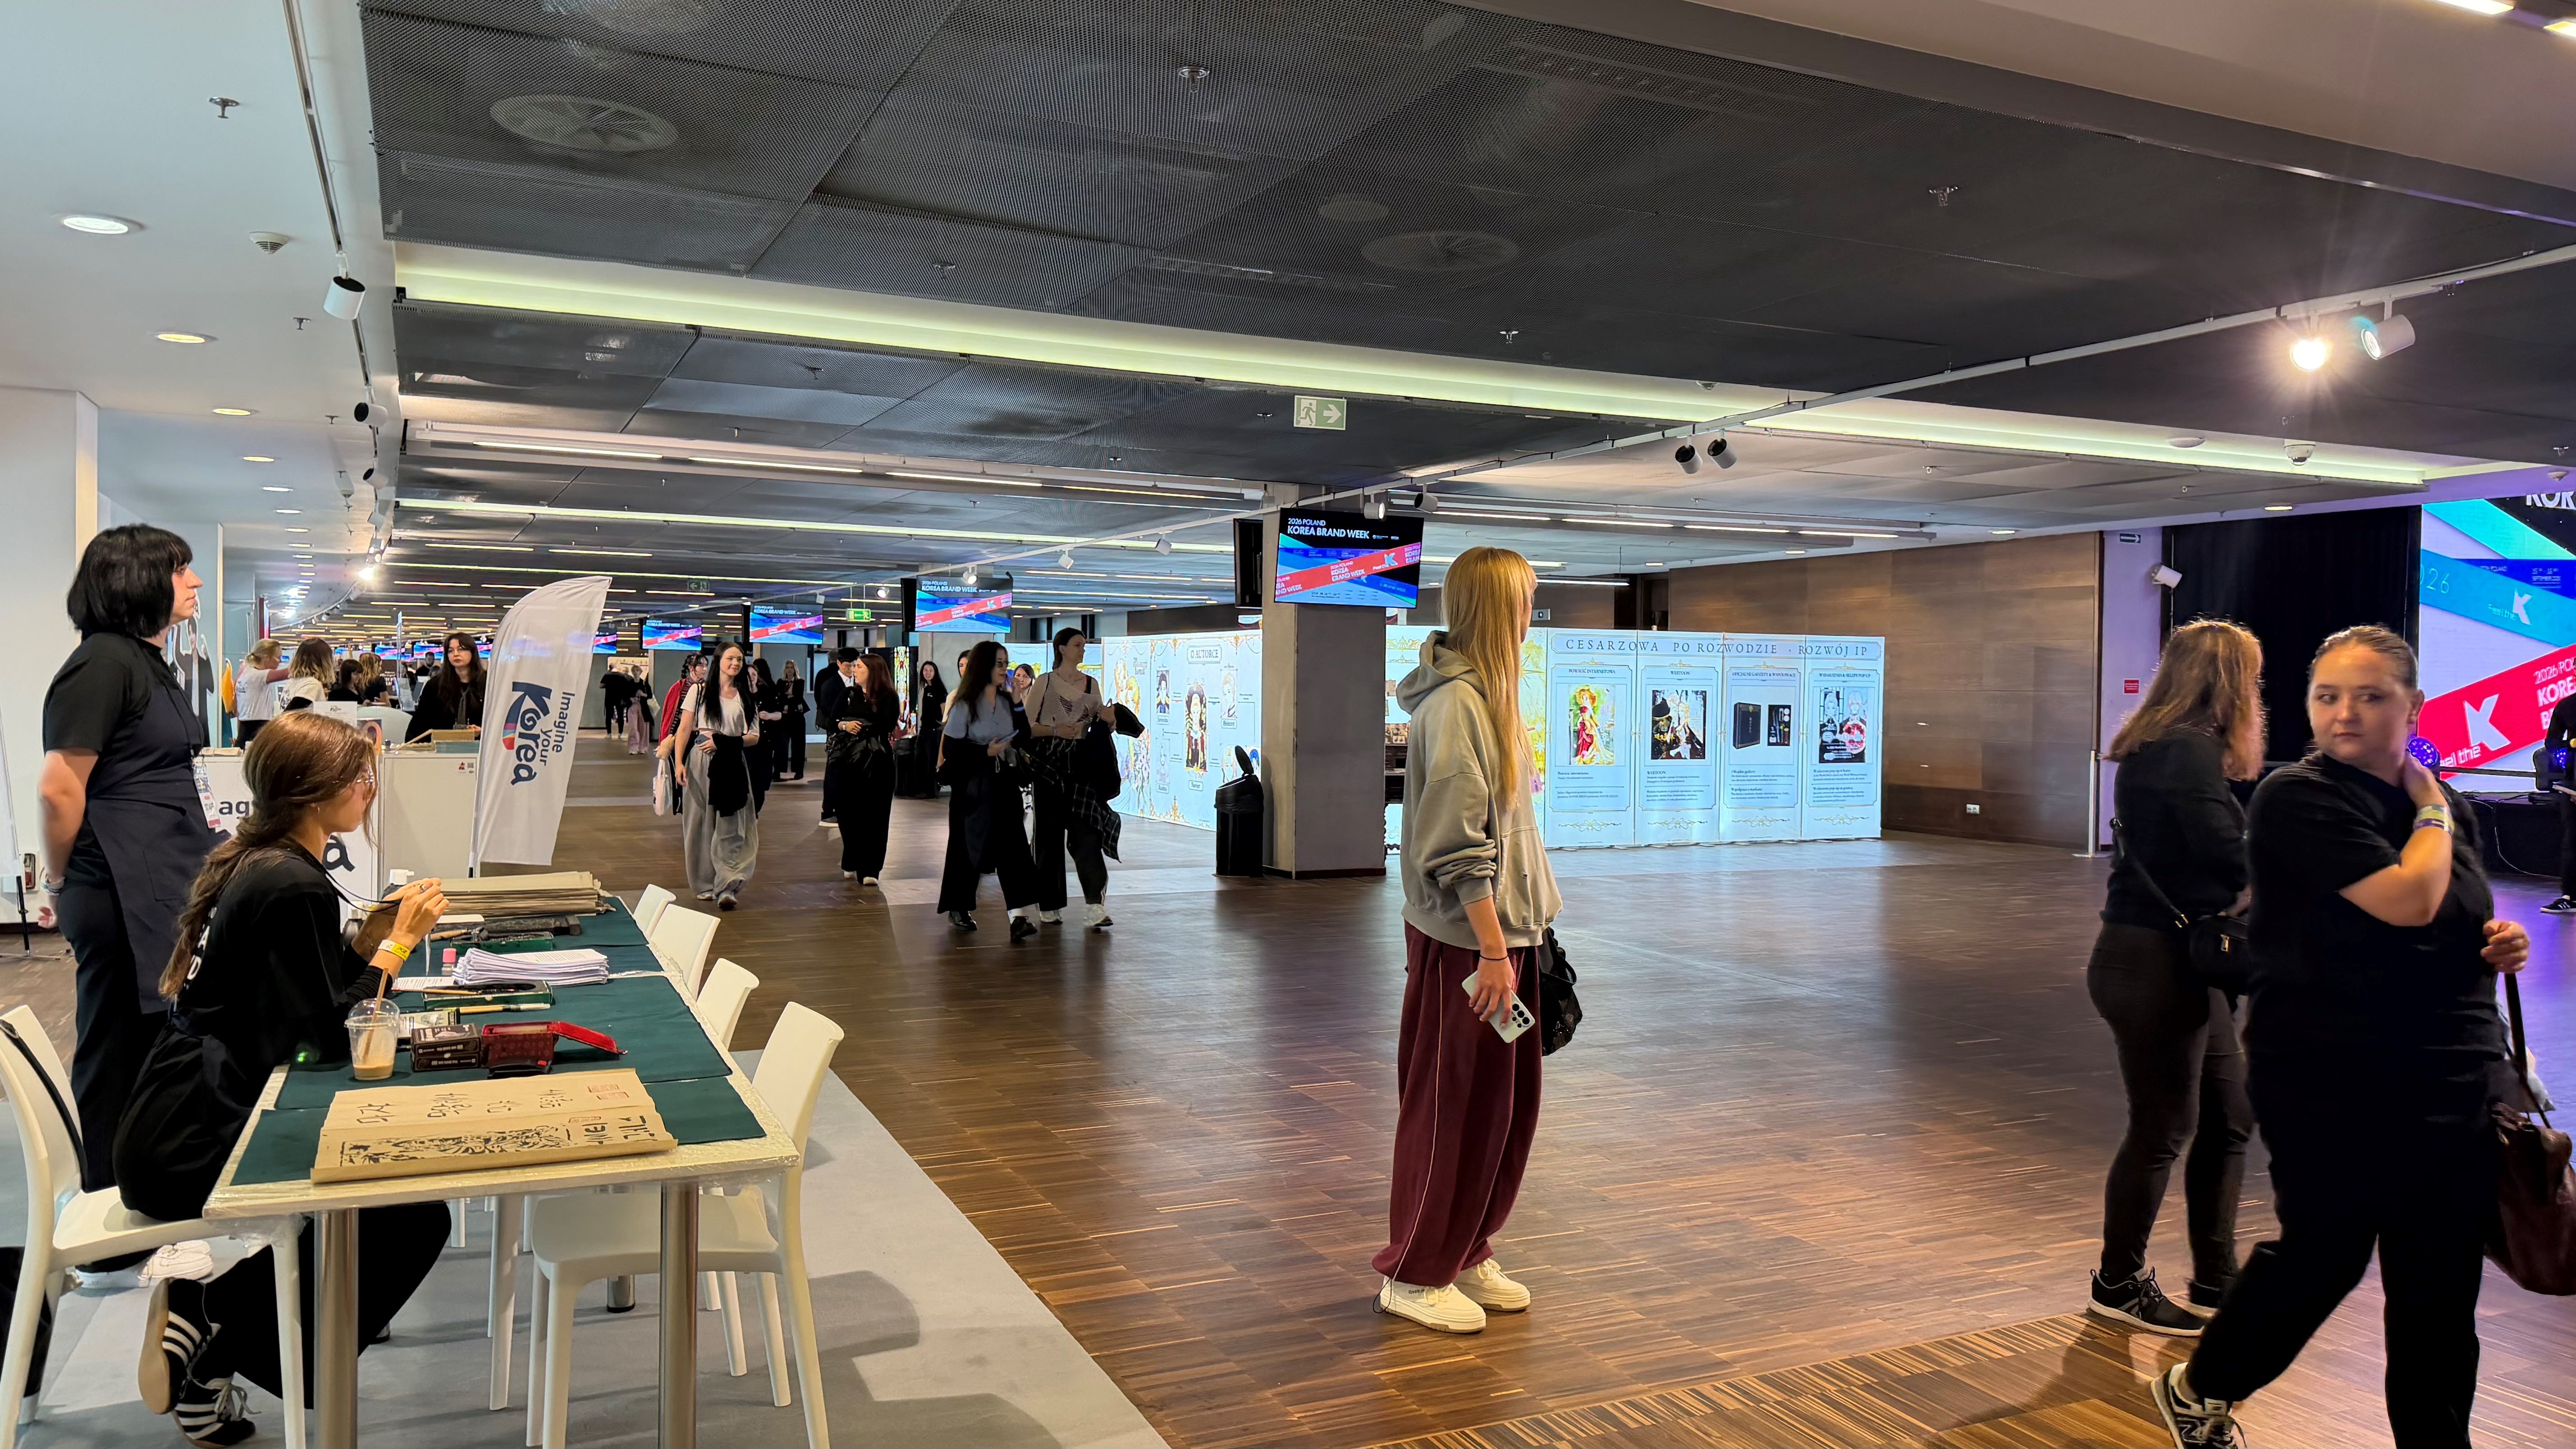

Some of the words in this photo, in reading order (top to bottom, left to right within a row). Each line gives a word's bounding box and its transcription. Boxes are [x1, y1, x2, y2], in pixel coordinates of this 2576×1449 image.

[1288, 525, 1314, 535] KOREA
[1317, 527, 1346, 538] BRAND
[1347, 529, 1369, 539] WEEK
[1331, 567, 1349, 575] KOREA
[1332, 573, 1351, 581] BRAND
[1351, 569, 1365, 578] WEEK
[1196, 649, 1219, 658] AUTORCE
[1566, 639, 1658, 652] CESARZOWA
[1673, 642, 1690, 652] PO
[1697, 643, 1777, 654] ROZWODZIE
[1798, 644, 1849, 658] ROZWÓJ
[1855, 646, 1867, 656] IP
[2533, 664, 2558, 685] 2026
[2537, 676, 2576, 707] KORE
[552, 691, 575, 753] Imagine
[2463, 693, 2512, 751] K
[502, 681, 552, 785] Korea
[539, 729, 553, 766] your
[2458, 745, 2481, 764] the
